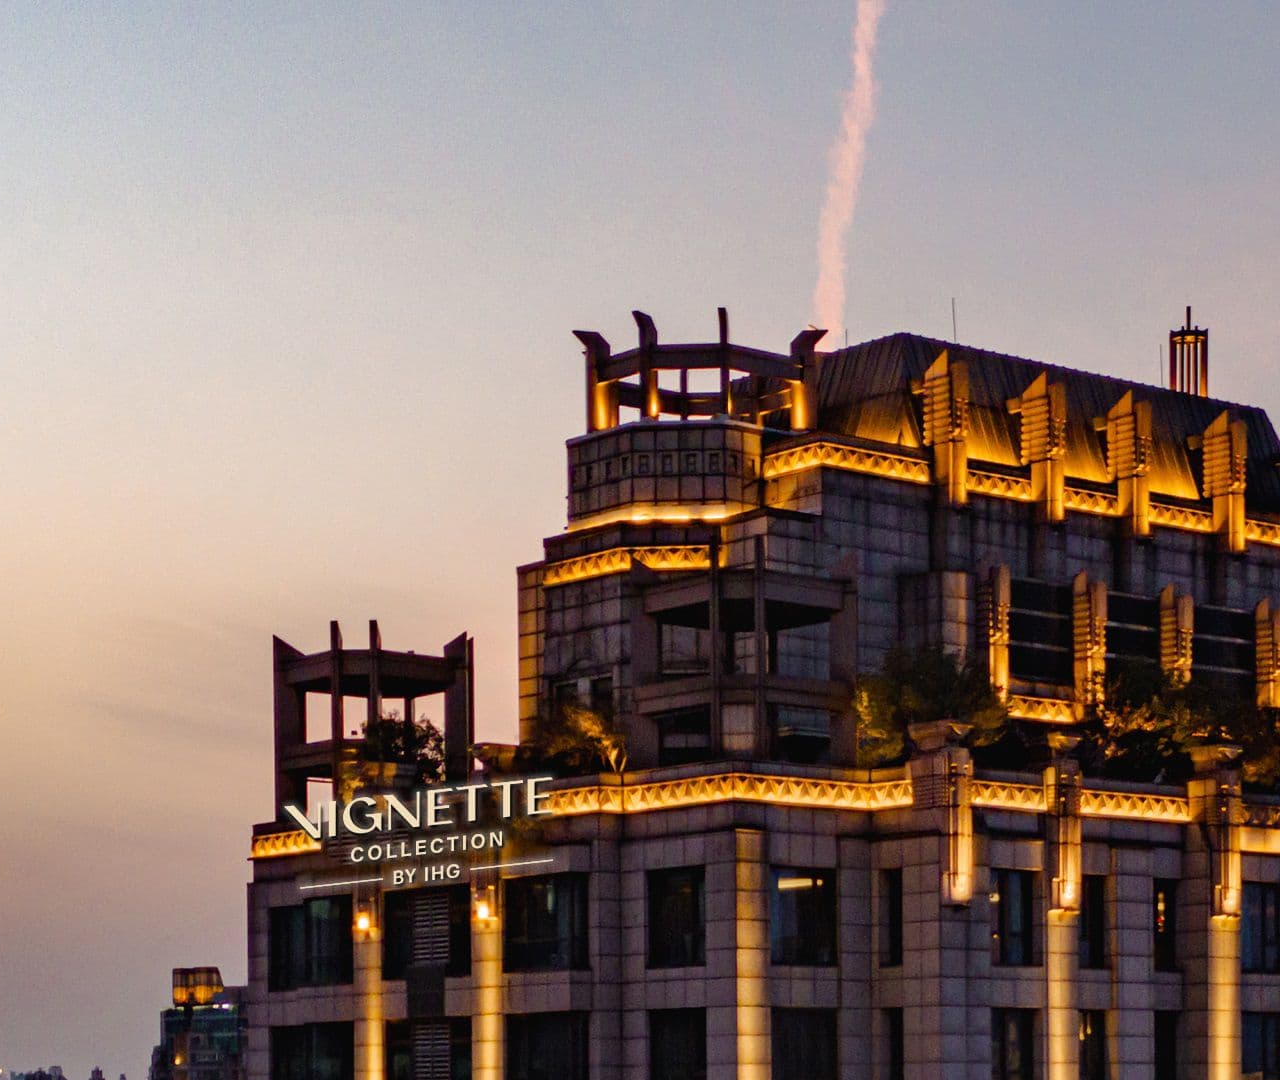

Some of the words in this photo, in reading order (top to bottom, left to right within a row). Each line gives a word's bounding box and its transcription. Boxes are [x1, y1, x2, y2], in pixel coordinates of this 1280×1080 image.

[284, 776, 553, 839] VIGNETTE
[350, 831, 503, 862] COLLECTION
[393, 869, 417, 885] BY
[424, 864, 461, 881] IHG
